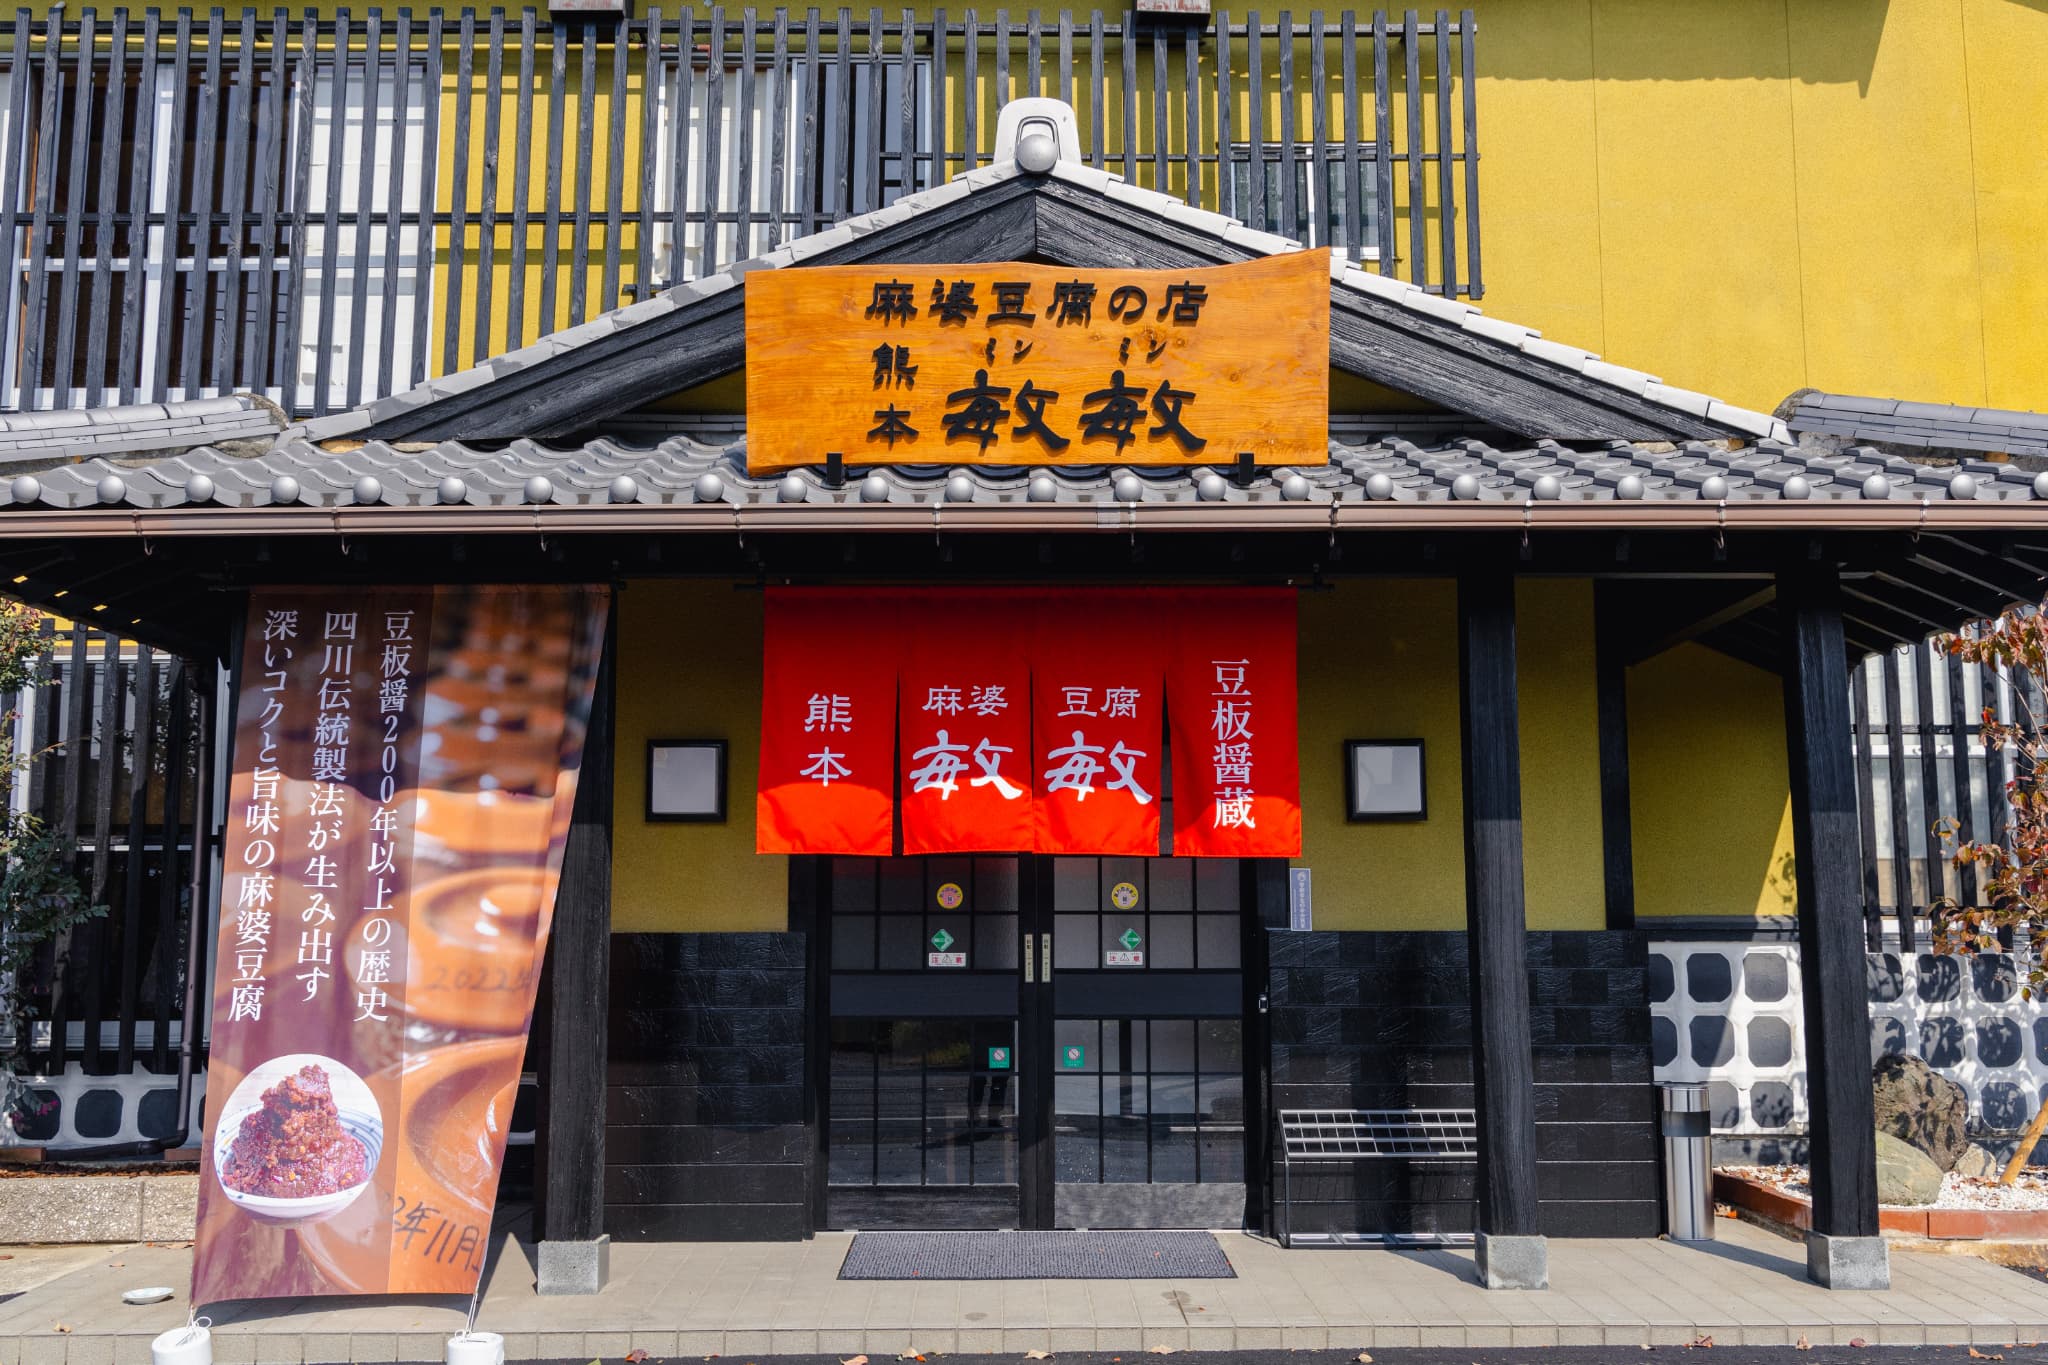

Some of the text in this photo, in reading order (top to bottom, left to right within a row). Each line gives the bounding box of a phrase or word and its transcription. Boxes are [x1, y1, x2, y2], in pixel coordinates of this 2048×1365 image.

[865, 278, 1208, 323] 麻婆豆腐の店
[867, 342, 920, 446] 熊本
[799, 693, 853, 788] 熊本
[921, 684, 1141, 719] 麻婆 豆腐
[1211, 658, 1256, 830] 豆板醤蔵
[228, 609, 299, 1022] 深いコクと旨味の麻婆豆腐
[296, 611, 358, 1002] 四川伝統製法が生み出す
[353, 609, 415, 1022] 豆板醤200年以上の歴史
